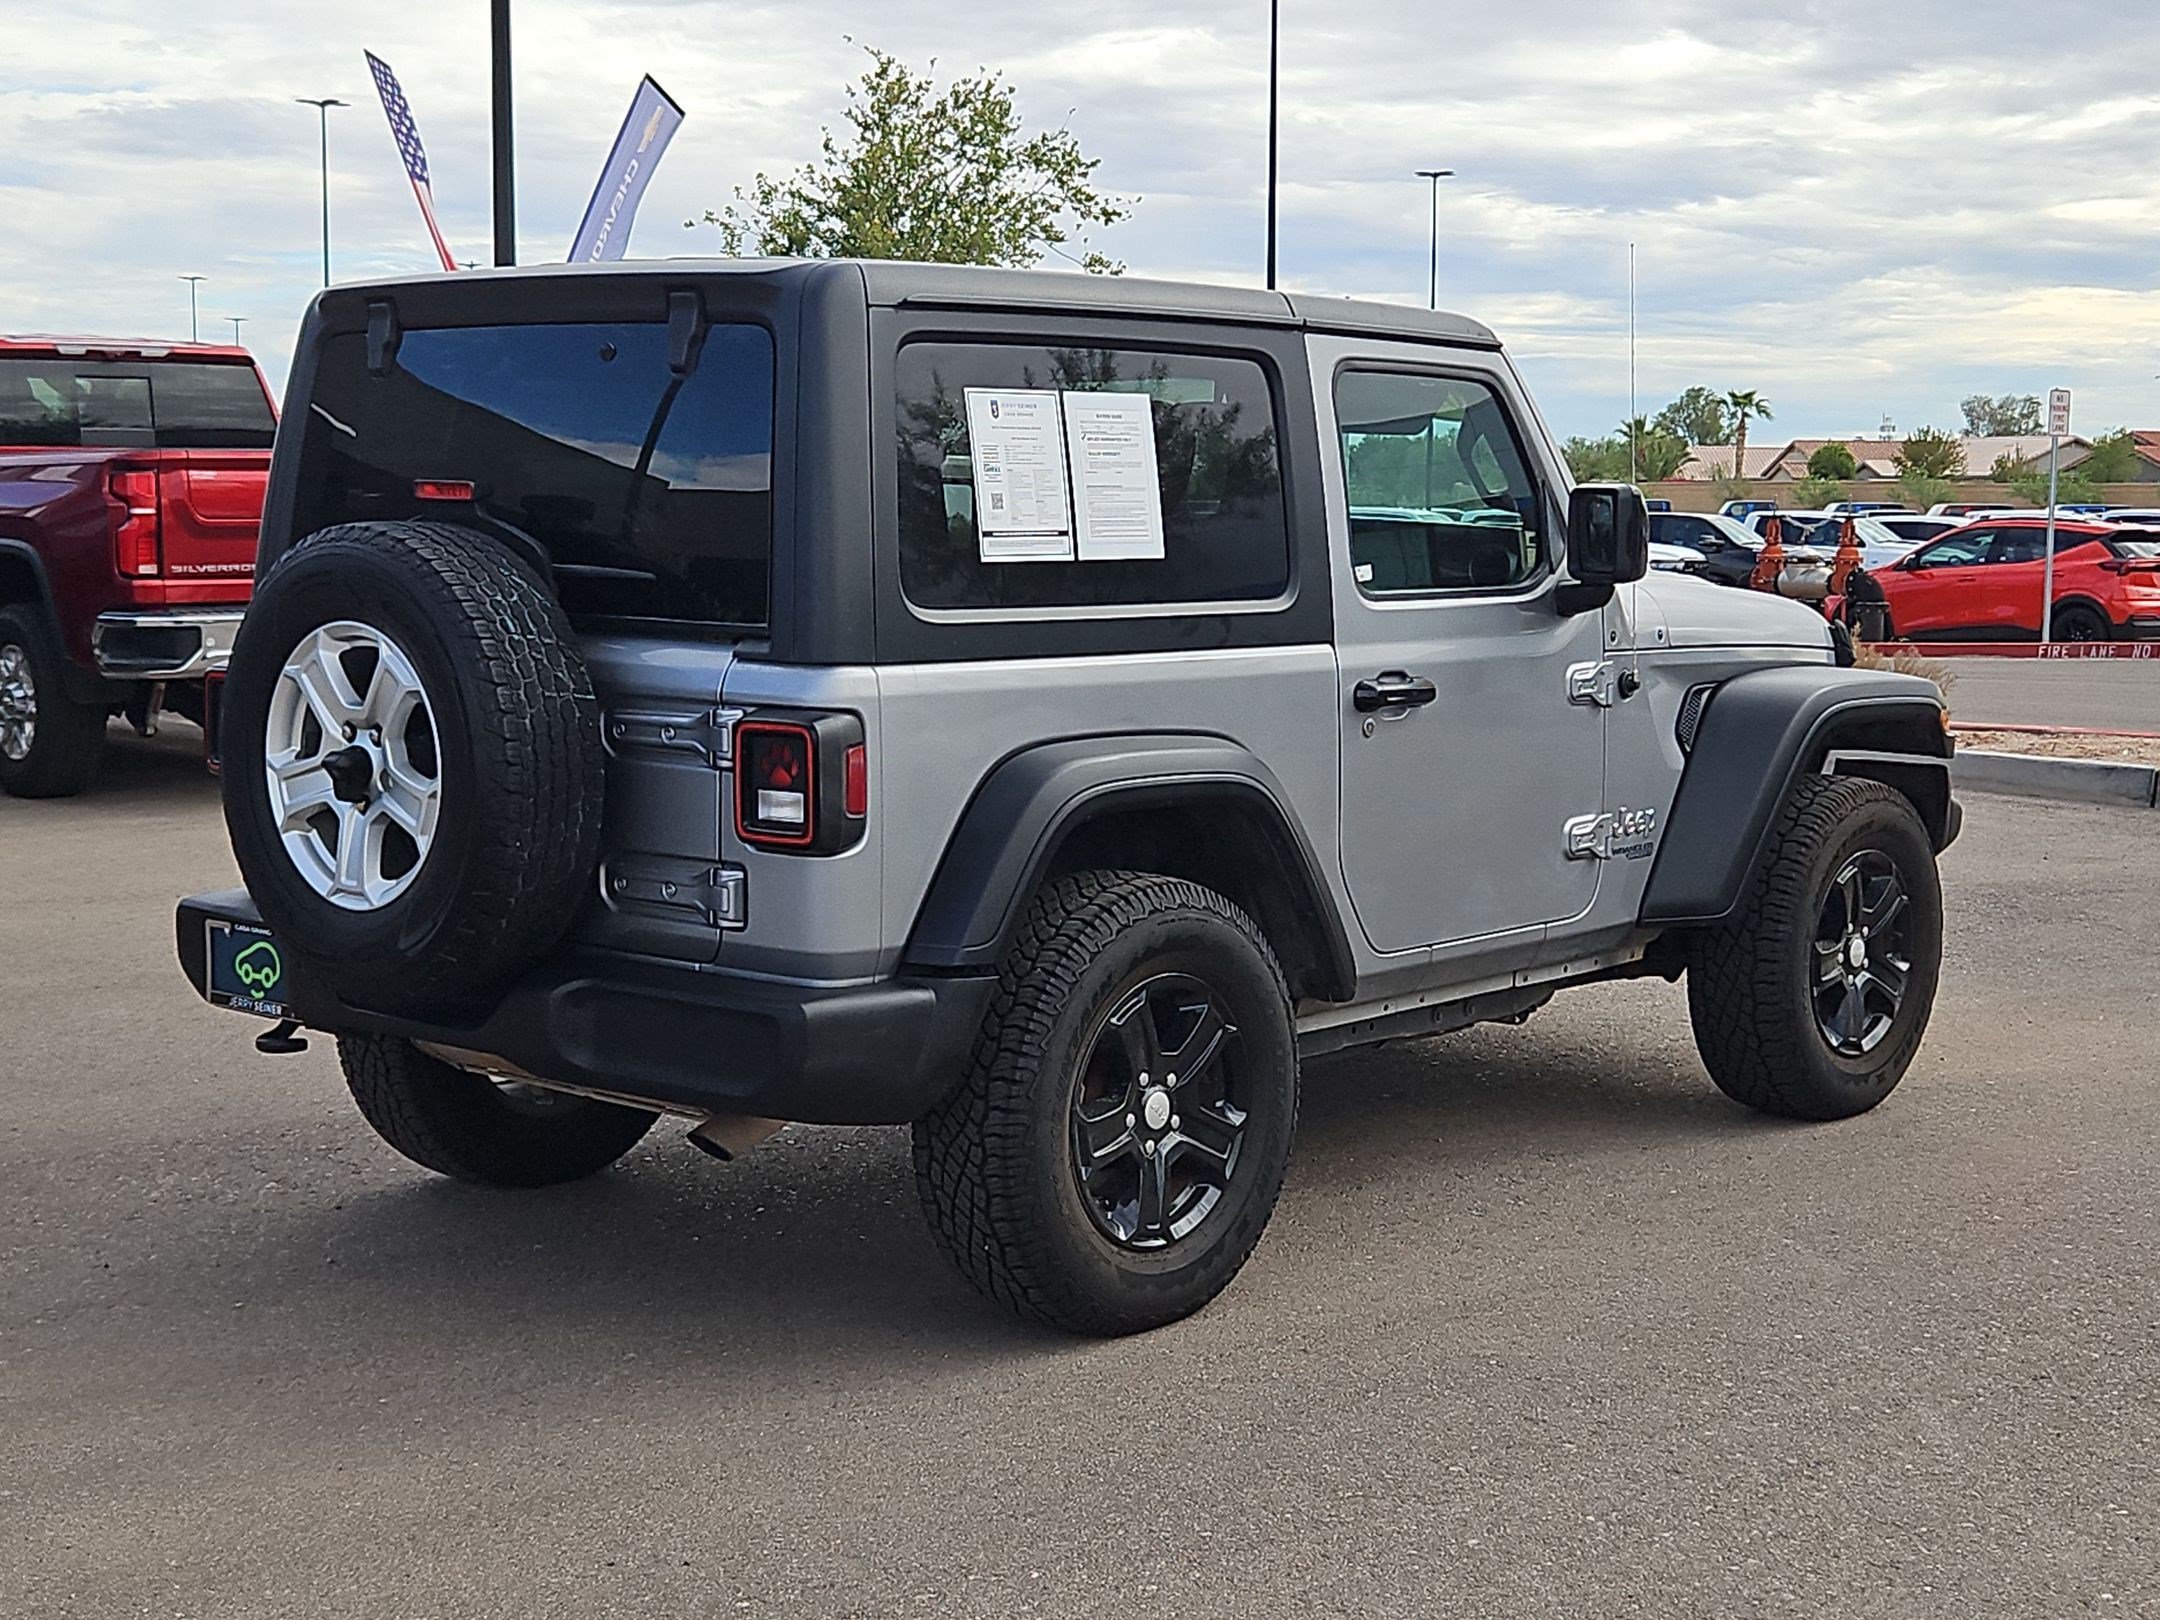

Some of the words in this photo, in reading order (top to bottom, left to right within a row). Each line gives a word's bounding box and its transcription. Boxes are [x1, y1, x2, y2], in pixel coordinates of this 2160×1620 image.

[2038, 645, 2070, 659] FIRE
[2080, 645, 2117, 659] LANE
[2132, 645, 2152, 659] NO
[1609, 805, 1656, 839] Jeep
